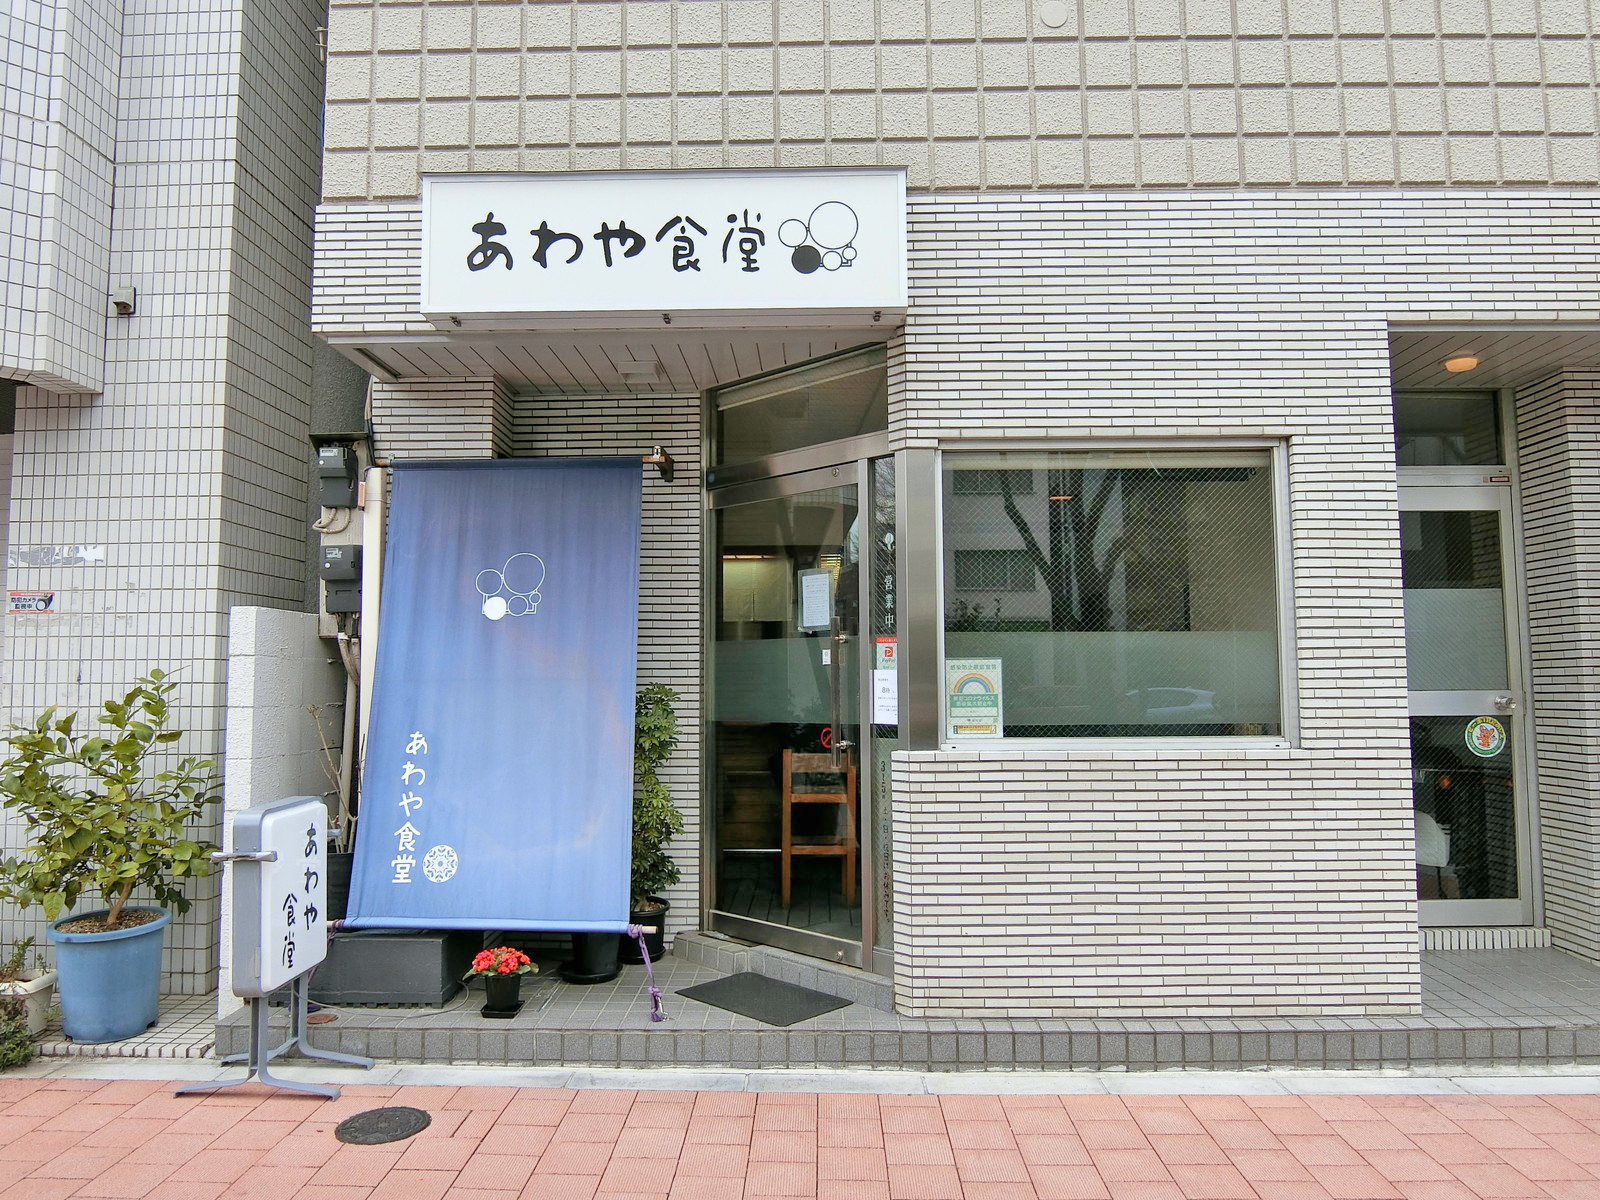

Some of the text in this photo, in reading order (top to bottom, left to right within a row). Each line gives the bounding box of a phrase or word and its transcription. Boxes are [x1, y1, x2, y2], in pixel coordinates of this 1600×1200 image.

[466, 208, 766, 273] あわや食堂
[884, 575, 894, 628] 営業中
[391, 731, 428, 884] あわや食堂
[304, 822, 318, 931] あわや
[282, 892, 298, 969] 食堂
